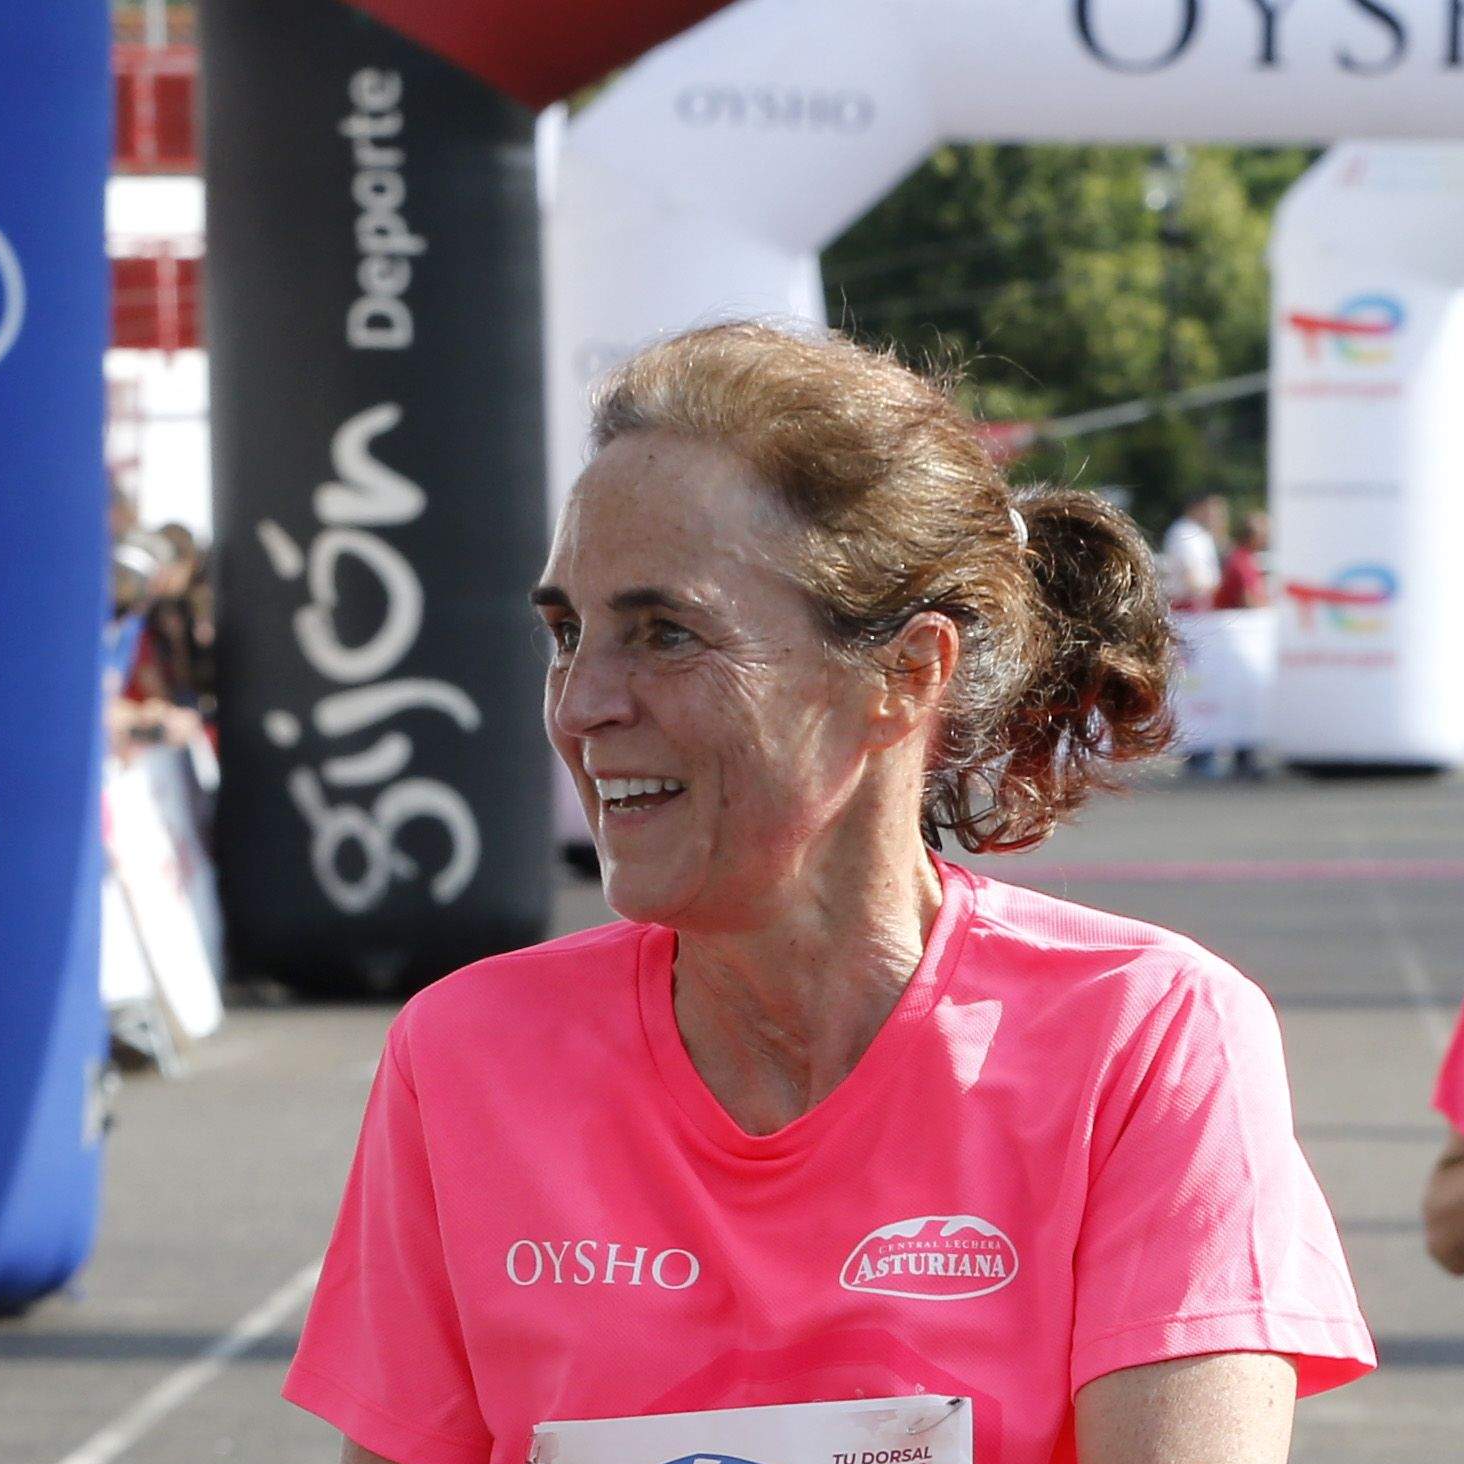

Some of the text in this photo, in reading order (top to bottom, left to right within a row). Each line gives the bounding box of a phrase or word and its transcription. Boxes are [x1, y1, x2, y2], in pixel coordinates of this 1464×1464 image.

[674, 85, 876, 134] OYSHO
[347, 65, 427, 351] Deporte
[505, 1239, 701, 1290] OYSHO
[850, 1252, 1007, 1286] ASTURIANA
[879, 1239, 1001, 1254] CENTRAL LECHERA
